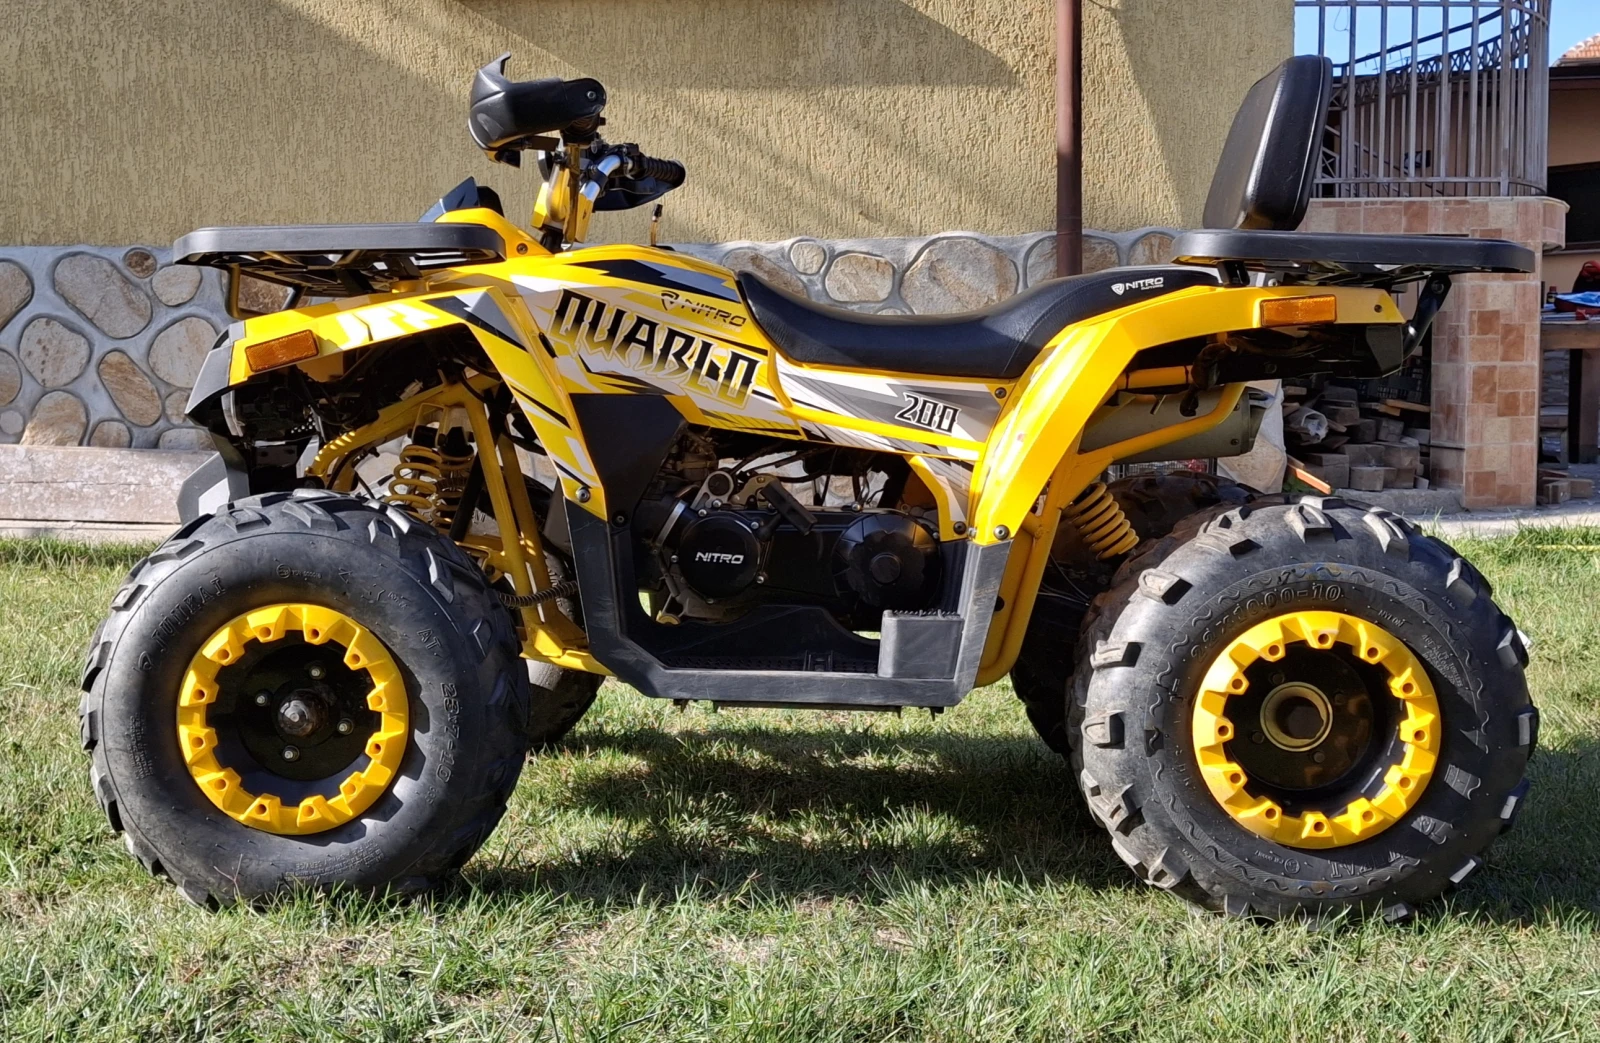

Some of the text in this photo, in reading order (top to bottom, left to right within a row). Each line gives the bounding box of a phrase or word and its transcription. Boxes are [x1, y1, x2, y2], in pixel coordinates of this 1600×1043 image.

[1125, 277, 1164, 291] NITRO
[681, 298, 747, 327] NITRO
[895, 391, 962, 436] 200
[694, 551, 745, 565] NITRO
[416, 628, 443, 651] AT
